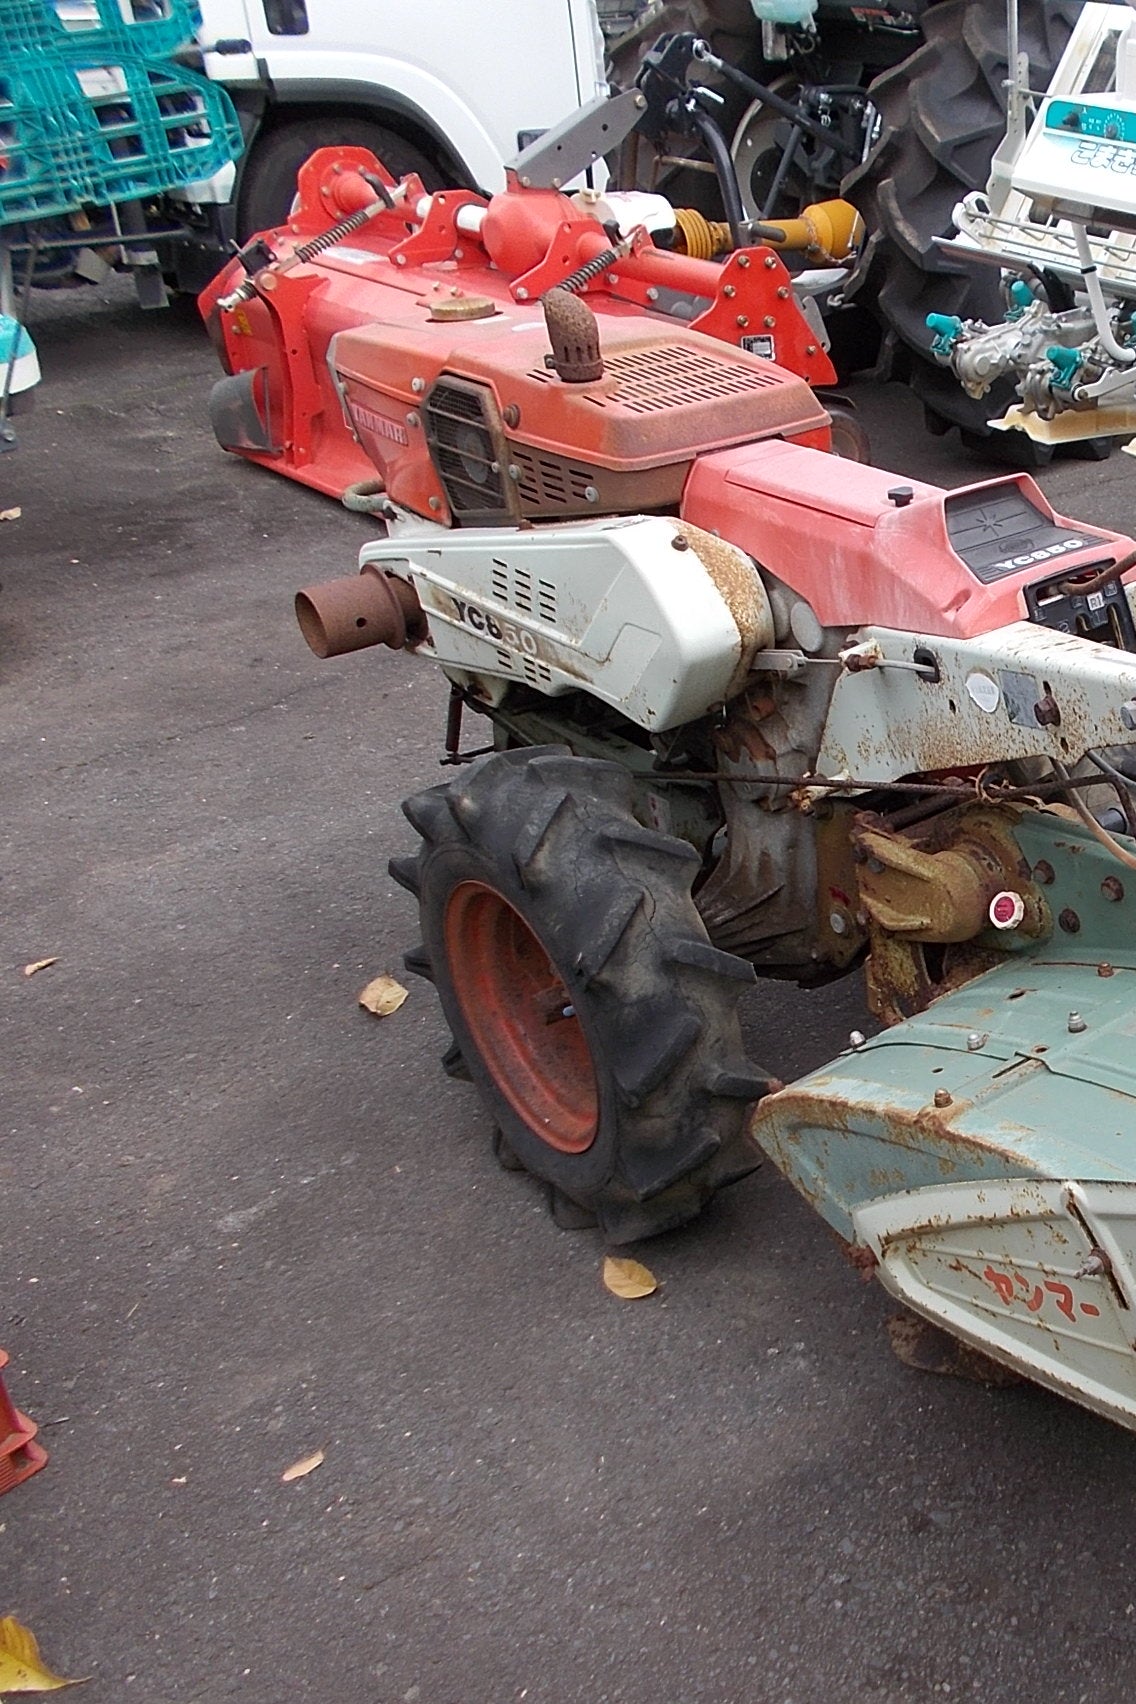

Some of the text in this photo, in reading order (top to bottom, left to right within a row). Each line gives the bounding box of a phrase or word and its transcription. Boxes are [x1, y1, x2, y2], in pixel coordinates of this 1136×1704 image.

[994, 538, 1084, 571] YC850
[450, 596, 538, 656] YC850
[983, 1264, 1101, 1323] ヤンマー
